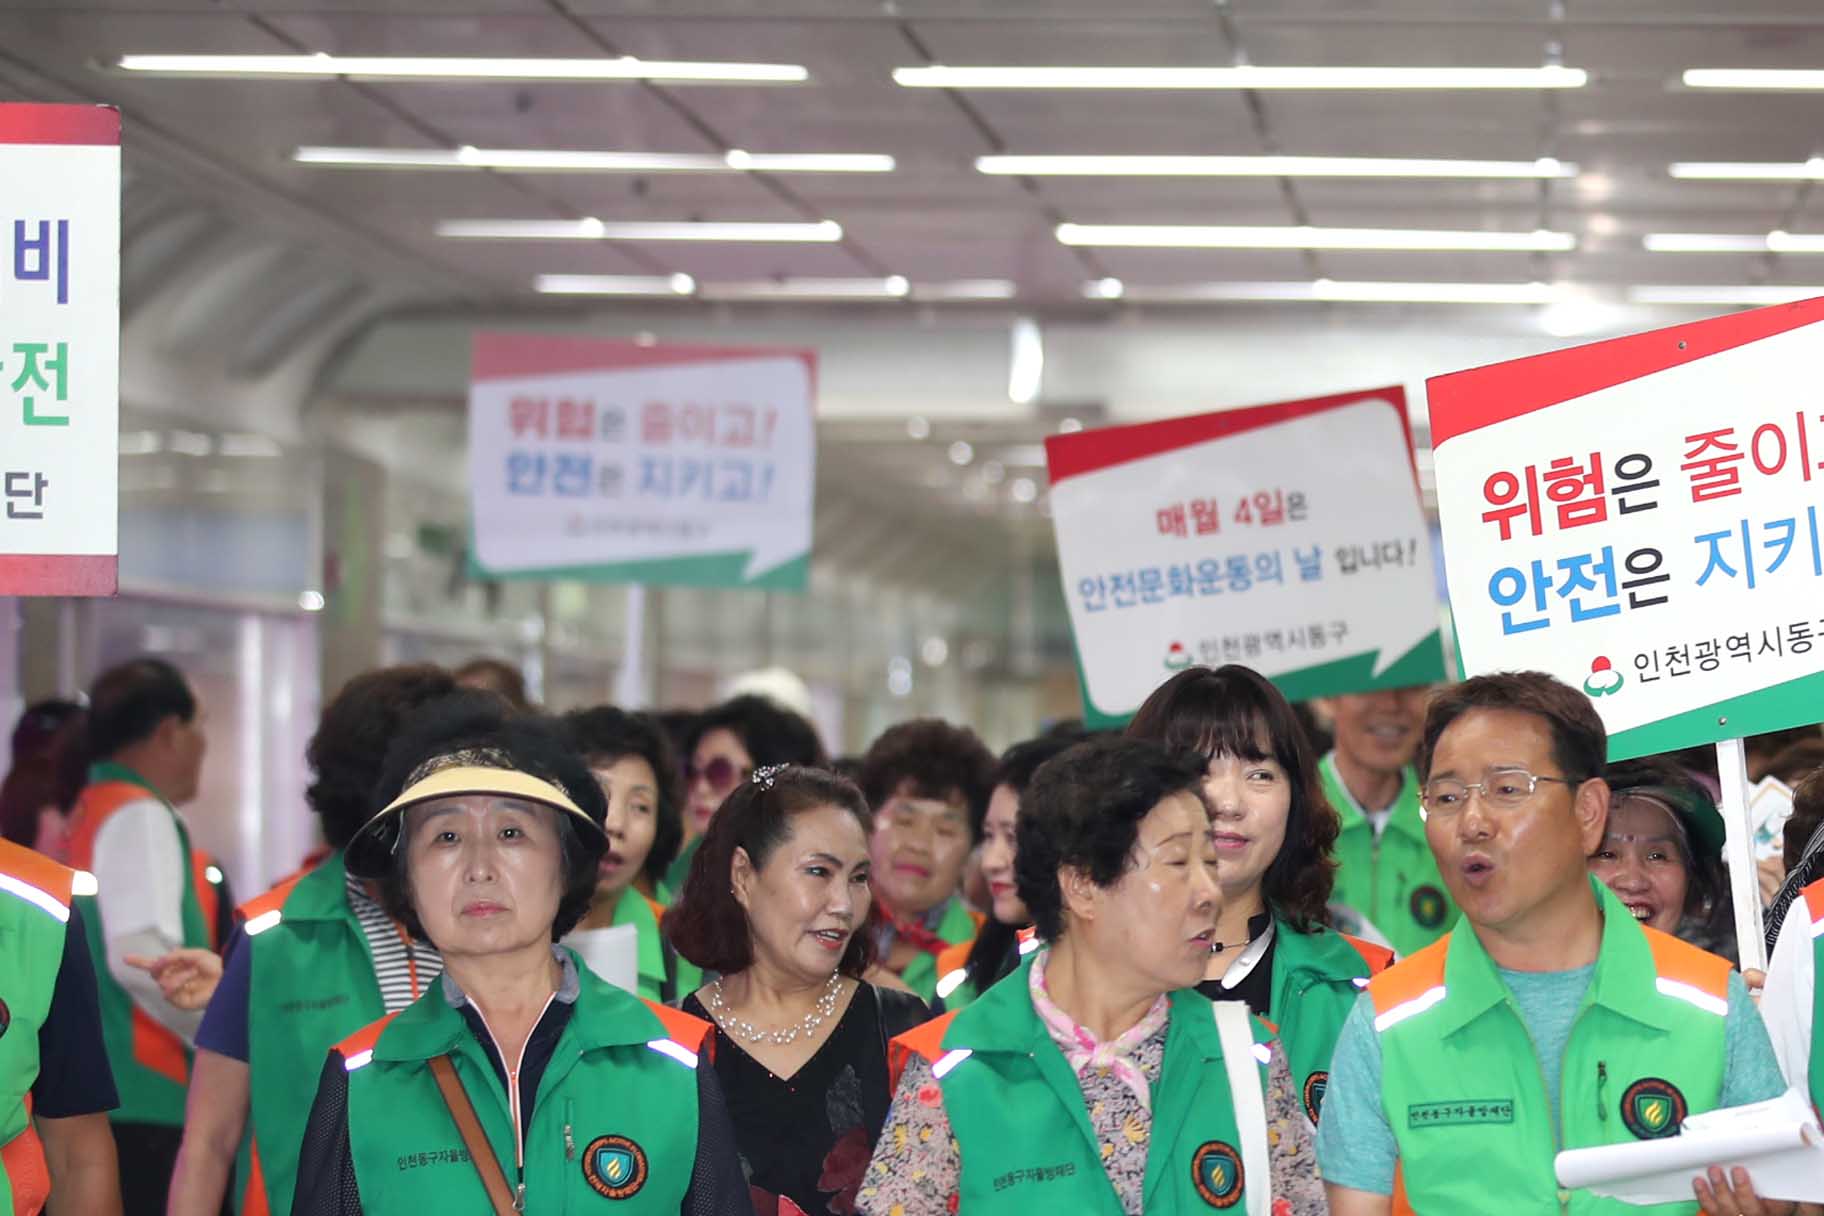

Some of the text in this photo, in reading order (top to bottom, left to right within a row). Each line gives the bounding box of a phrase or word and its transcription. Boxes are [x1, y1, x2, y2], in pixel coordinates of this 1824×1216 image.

[13, 219, 69, 304] 비
[0, 342, 70, 426] 전
[5, 472, 49, 519] 단
[1156, 490, 1308, 538] 매월 4일은
[1482, 452, 1661, 542] 위험은
[1077, 538, 1418, 613] 안전문화운동의 날 입니다!
[1488, 545, 1671, 636] 안전은
[397, 1148, 471, 1171] 인천동구자율방
